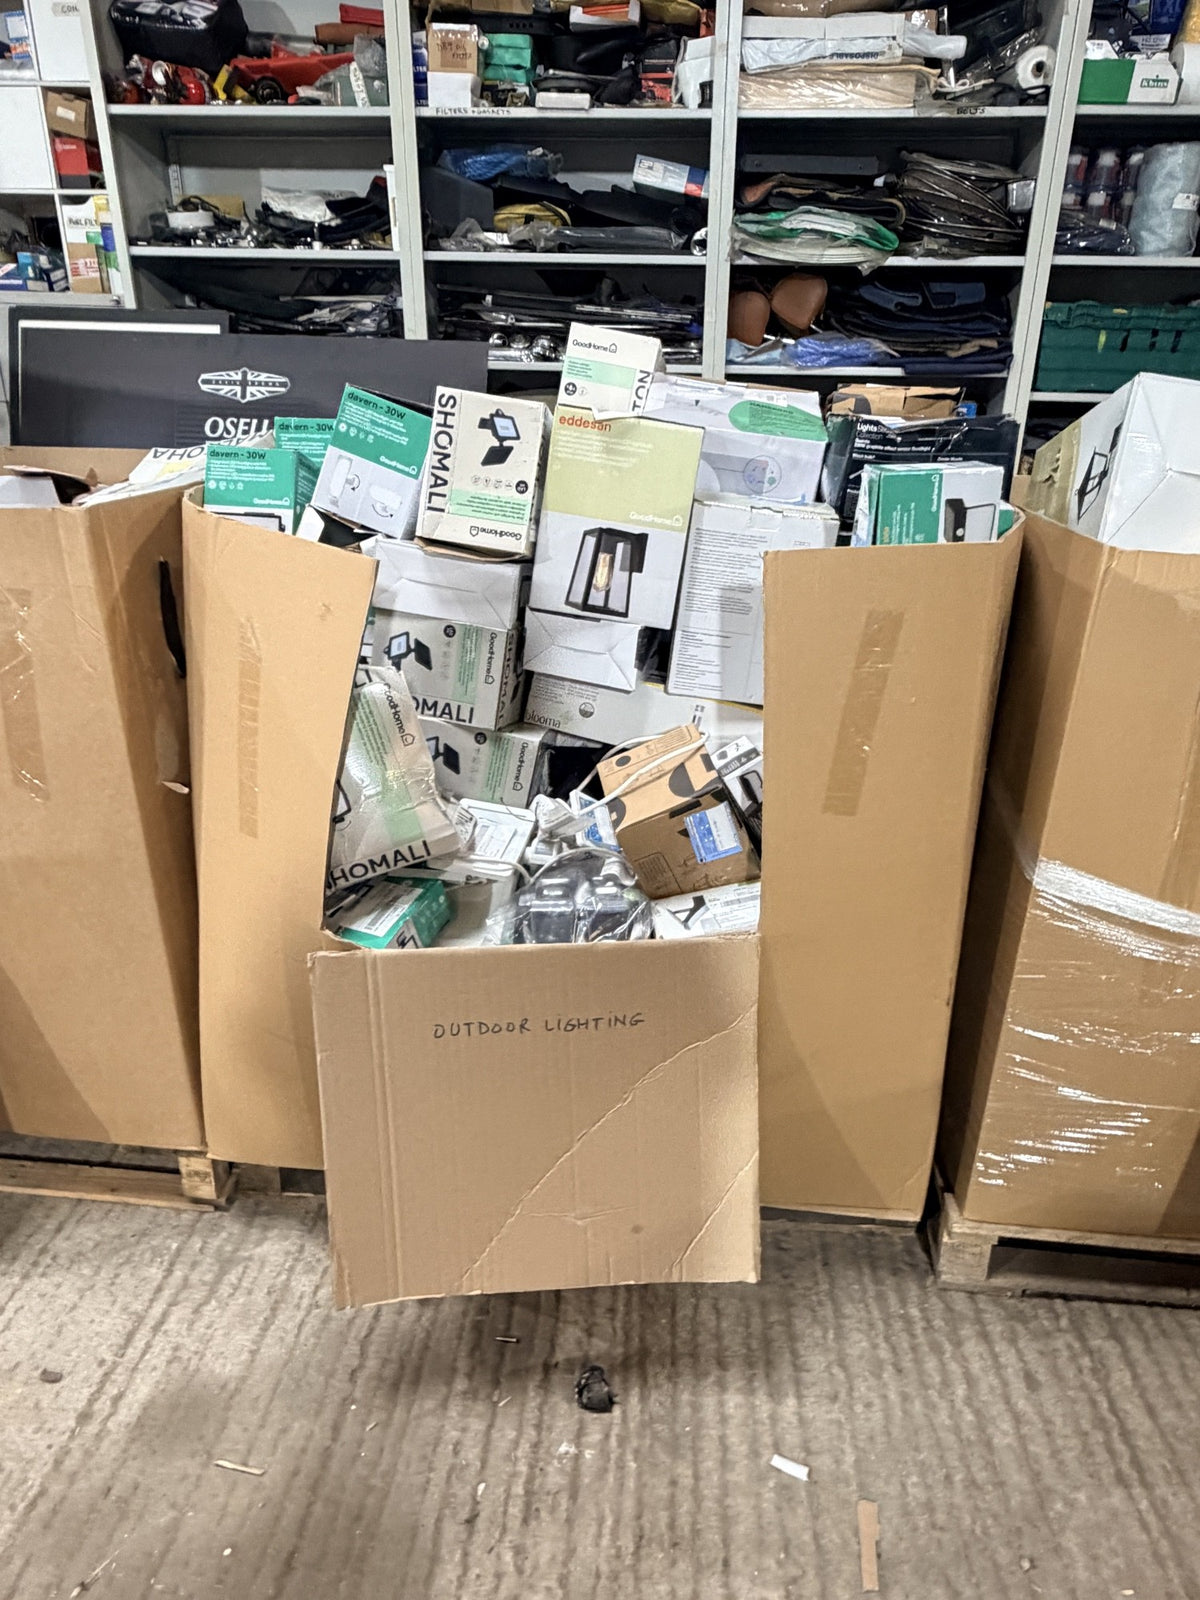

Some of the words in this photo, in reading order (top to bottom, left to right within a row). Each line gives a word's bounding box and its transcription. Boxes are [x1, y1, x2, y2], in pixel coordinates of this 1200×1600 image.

[572, 339, 609, 352] GoodHome
[348, 392, 378, 410] davern
[384, 405, 407, 420] 30W
[559, 415, 612, 432] eddesan
[209, 449, 240, 459] davern
[246, 451, 267, 460] 30W
[426, 393, 457, 513] SHOMALI
[479, 526, 522, 541] GoodHome
[485, 631, 498, 676] GoodHome
[514, 741, 529, 783] GoodHome
[433, 1017, 531, 1039] OUTDOOR
[545, 1011, 646, 1033] LIGHTING
